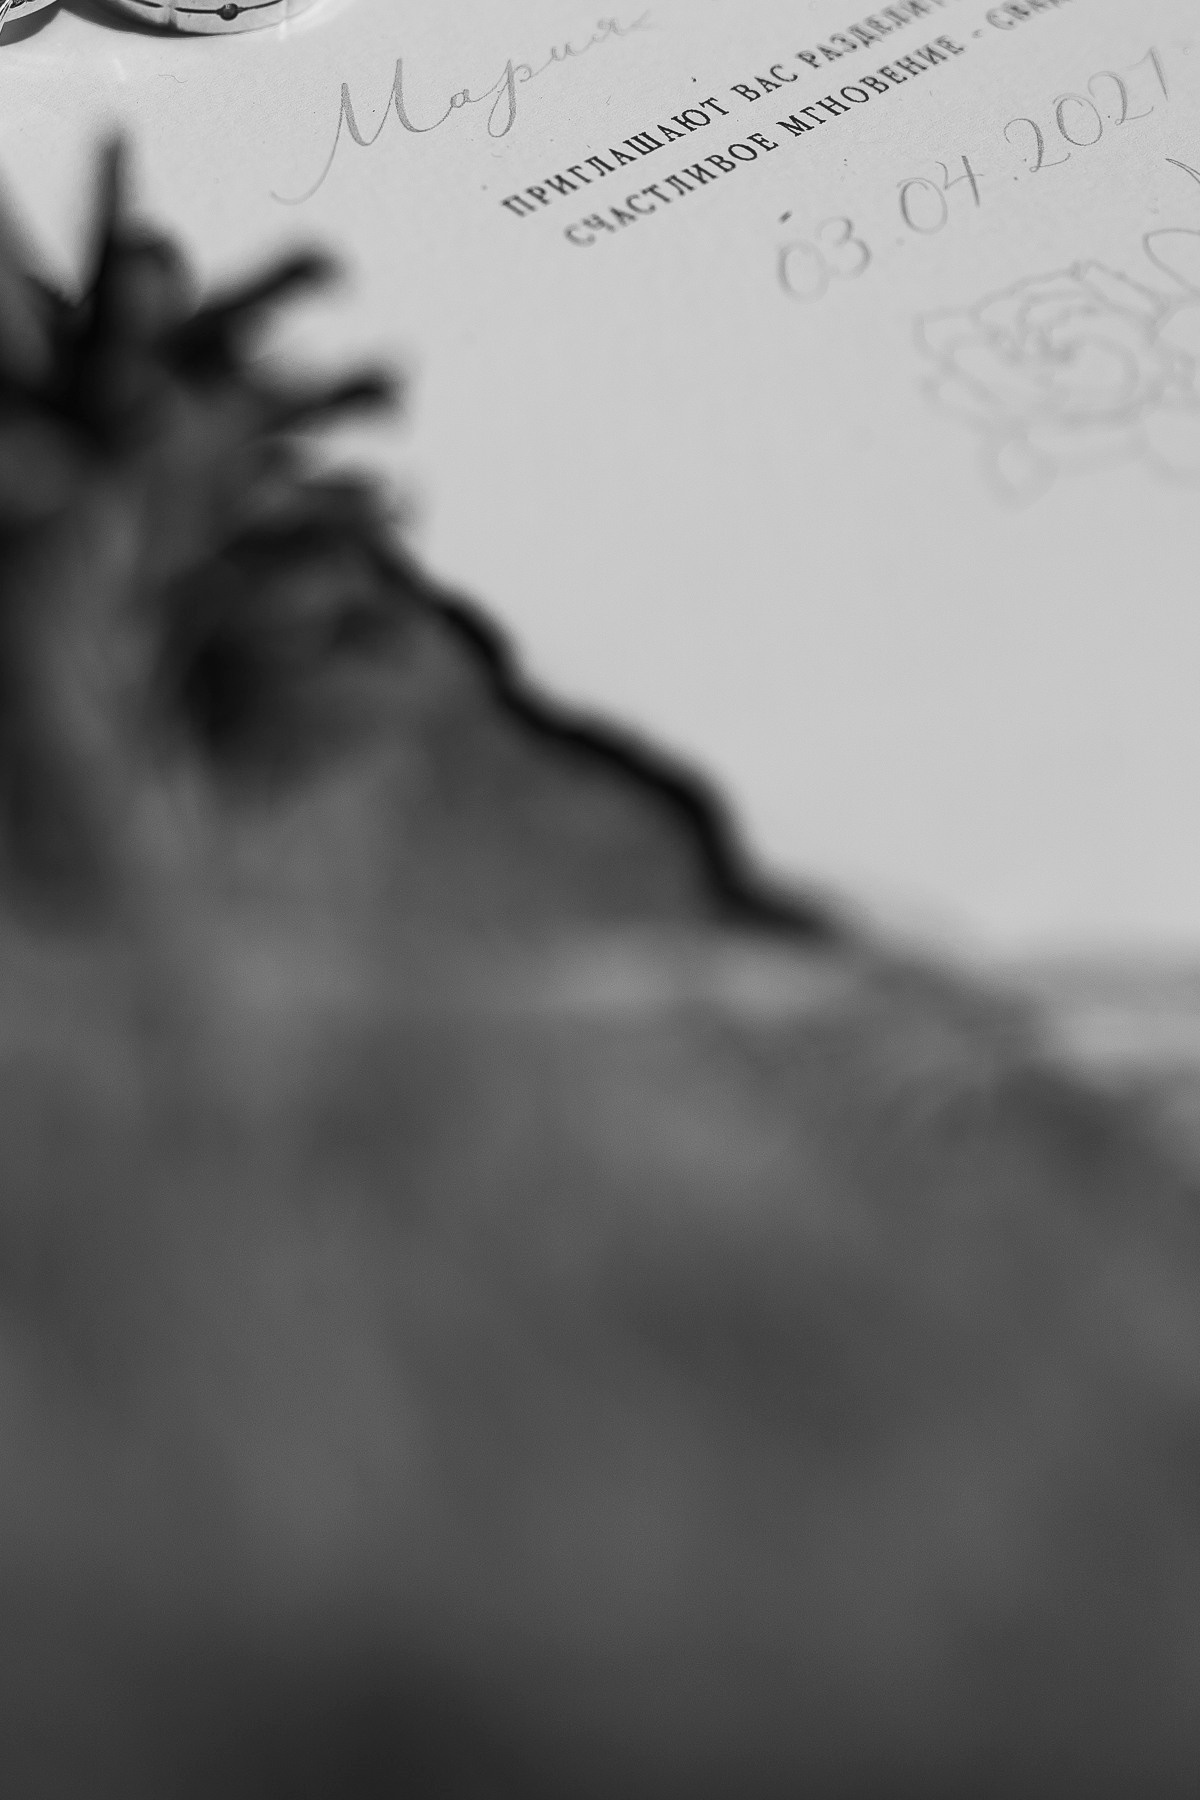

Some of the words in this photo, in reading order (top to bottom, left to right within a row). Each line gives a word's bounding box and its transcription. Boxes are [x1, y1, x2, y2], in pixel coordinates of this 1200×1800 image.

[270, 10, 653, 206] Мария
[500, 96, 728, 218] ПРИГЛАШАЮТ
[731, 63, 799, 101] ВАС
[562, 132, 778, 247] СЧАСТЛИВОЕ
[776, 34, 965, 137] МГНОВЕНИЕ
